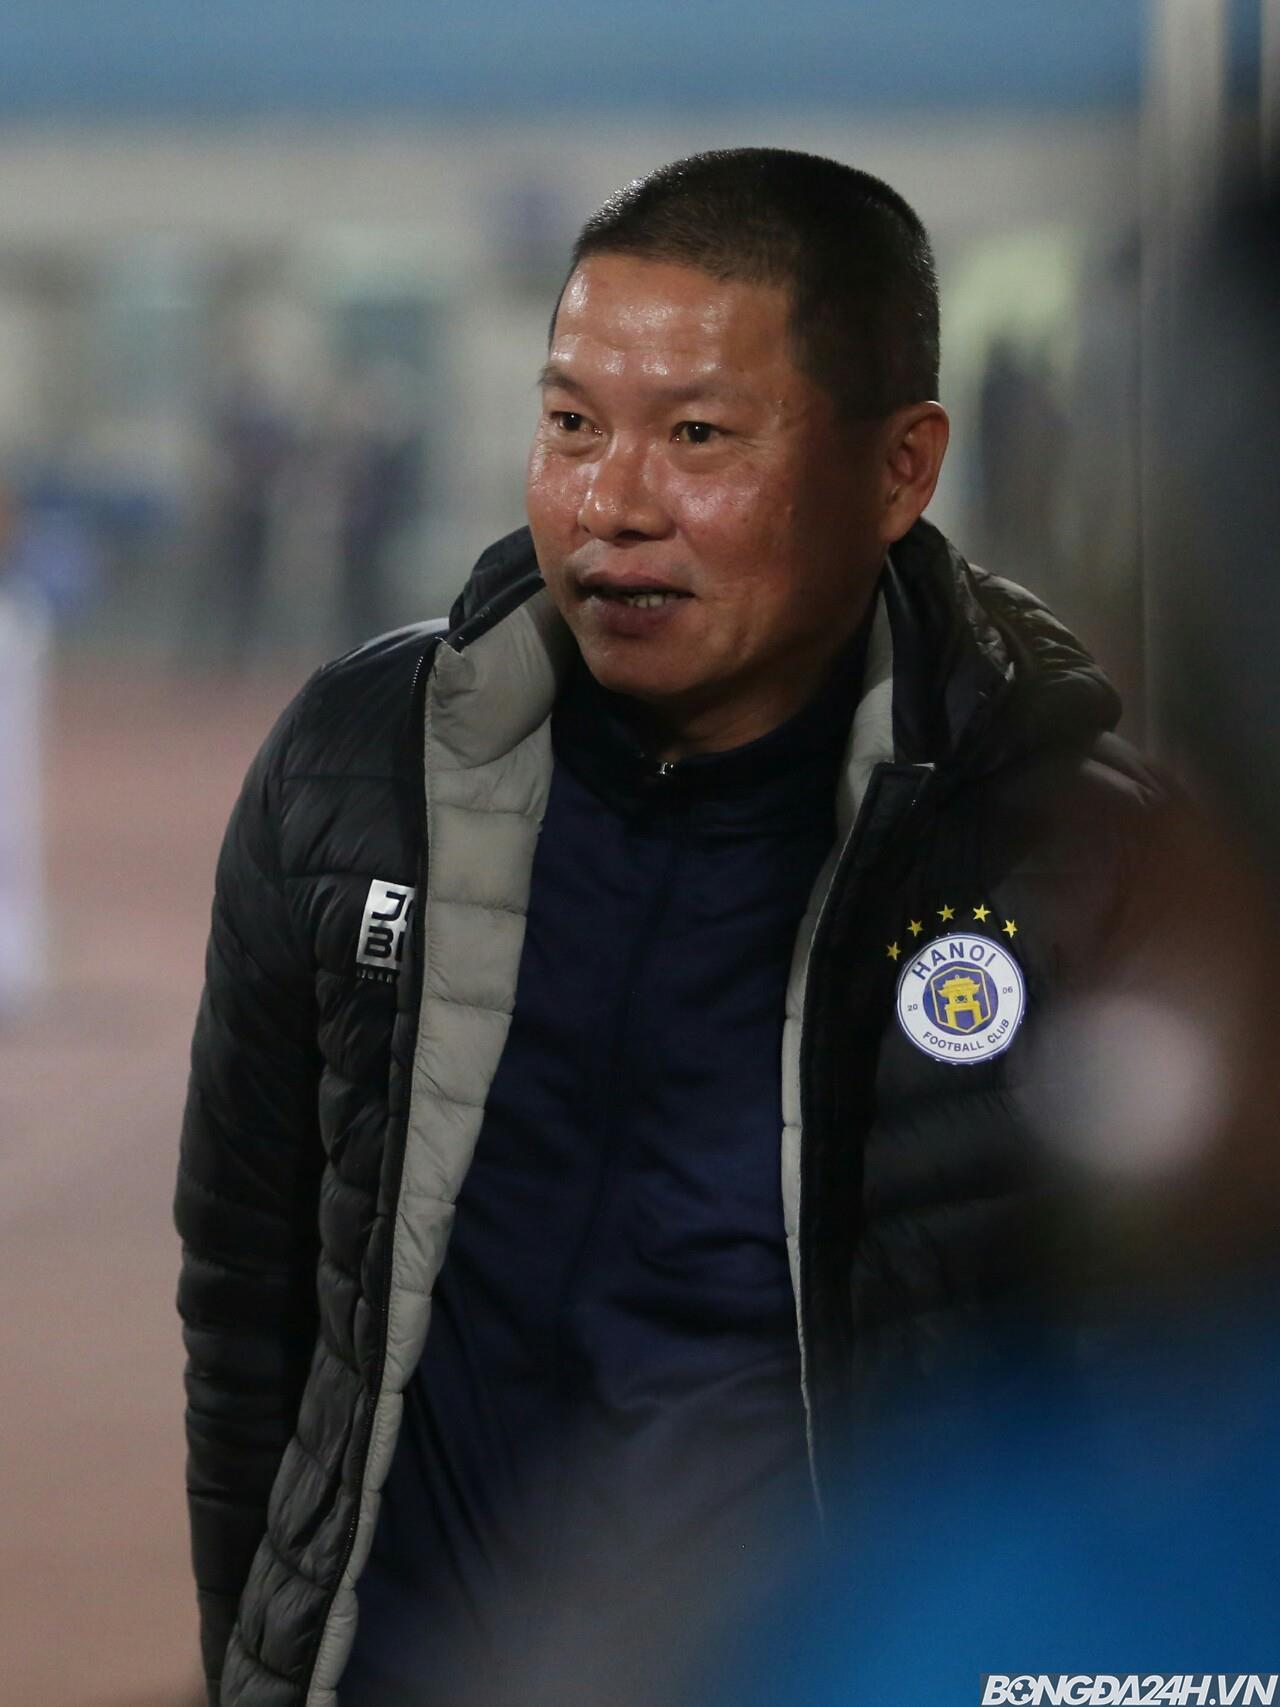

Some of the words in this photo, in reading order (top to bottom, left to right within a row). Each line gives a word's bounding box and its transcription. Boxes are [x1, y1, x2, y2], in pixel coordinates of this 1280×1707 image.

[911, 942, 996, 980] HANOI
[1002, 985, 1014, 995] 06
[907, 1003, 918, 1012] 20
[923, 1031, 984, 1052] FOOTBALL
[987, 1018, 1010, 1044] CLUB
